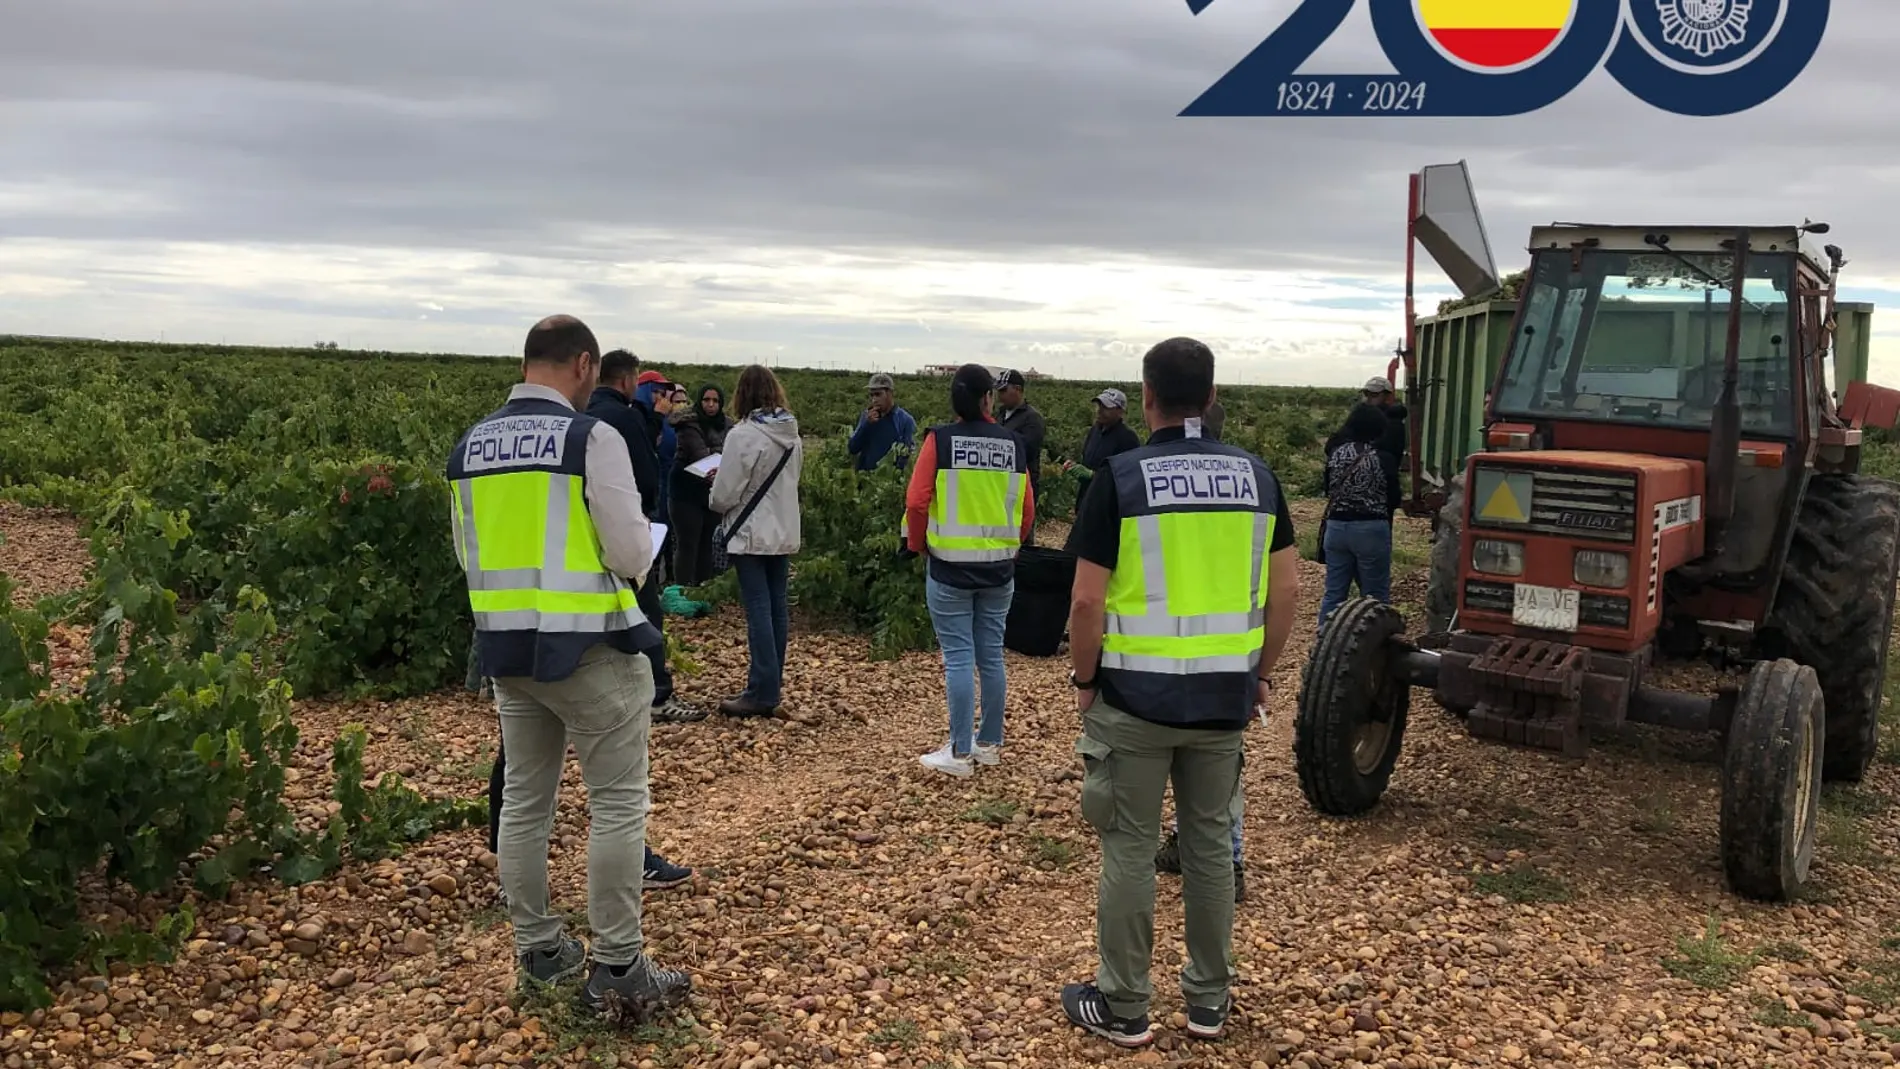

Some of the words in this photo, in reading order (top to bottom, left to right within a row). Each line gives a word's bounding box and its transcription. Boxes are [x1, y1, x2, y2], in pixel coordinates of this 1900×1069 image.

[505, 419, 547, 432] NACIONAL
[550, 420, 567, 431] DE
[467, 434, 557, 465] POLICIA
[954, 449, 1014, 469] POLICIA
[1146, 459, 1190, 473] CUERPO
[1191, 459, 1237, 471] NACIONAL
[1149, 475, 1255, 500] POLICIA
[1562, 512, 1619, 527] FIAT
